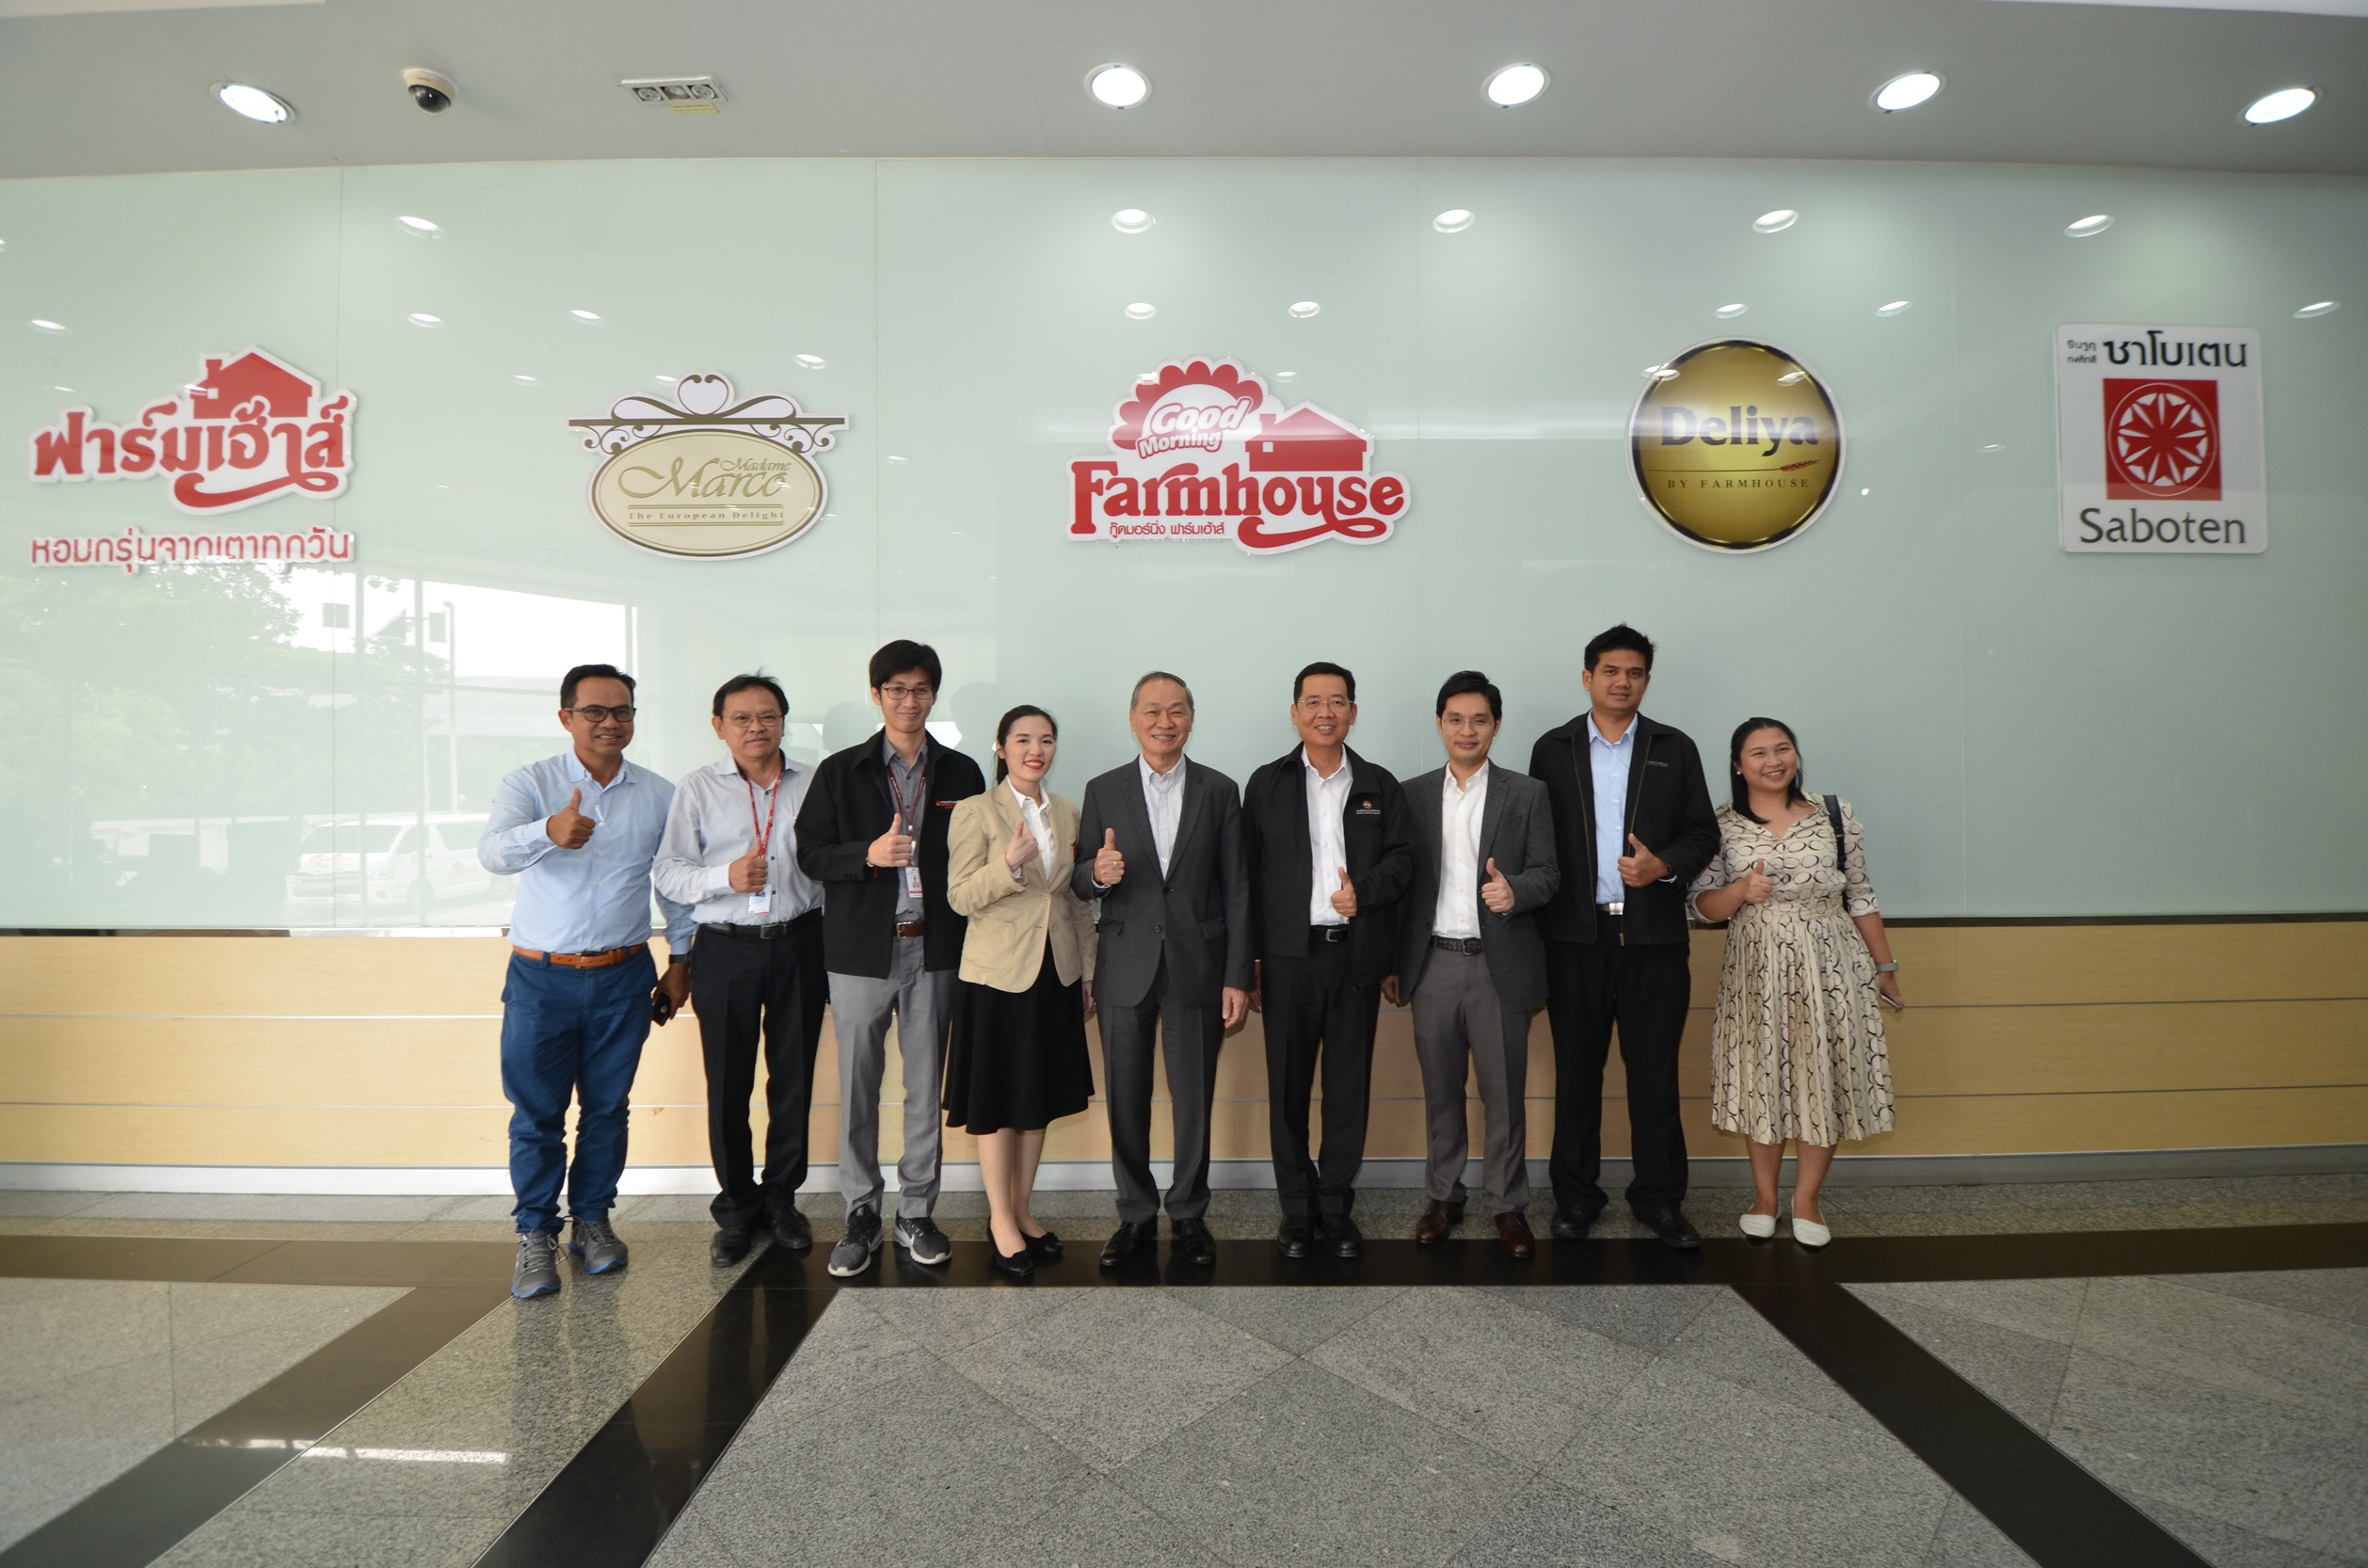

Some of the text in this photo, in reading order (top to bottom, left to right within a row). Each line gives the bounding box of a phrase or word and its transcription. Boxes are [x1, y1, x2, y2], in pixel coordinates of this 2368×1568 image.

[1151, 397, 1252, 435] Good
[1660, 406, 1818, 456] Deliya
[34, 395, 349, 508] ฟาร์มเฮ้าส์
[1137, 426, 1223, 458] Morning
[720, 457, 792, 471] Madame
[1668, 479, 1809, 488] BY FARMHOUSE
[660, 512, 726, 520] European
[732, 511, 784, 520] Delight
[1070, 461, 1404, 548] Farmhouse
[2079, 508, 2247, 544] Saboten
